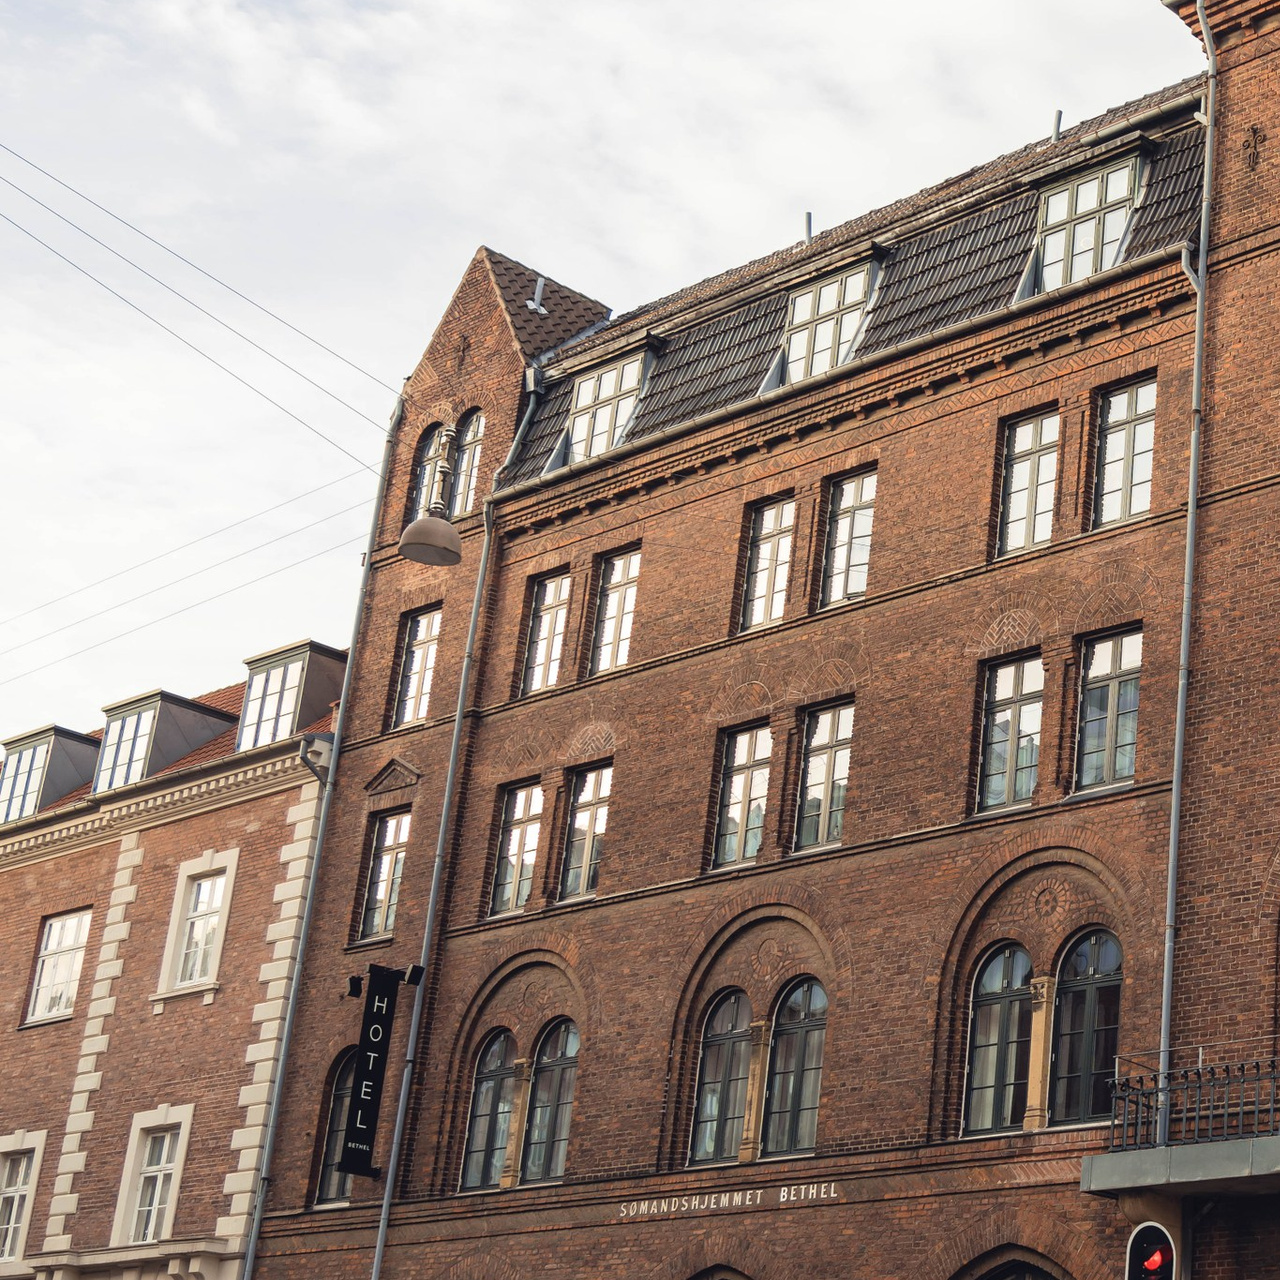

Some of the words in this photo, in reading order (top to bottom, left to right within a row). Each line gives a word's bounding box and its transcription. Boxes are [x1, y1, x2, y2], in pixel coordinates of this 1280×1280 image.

[356, 995, 388, 1129] HOTEL
[348, 1141, 370, 1151] BETHEL
[619, 1189, 764, 1217] SØMANDSHJEMMET
[779, 1182, 838, 1202] BETHEL
